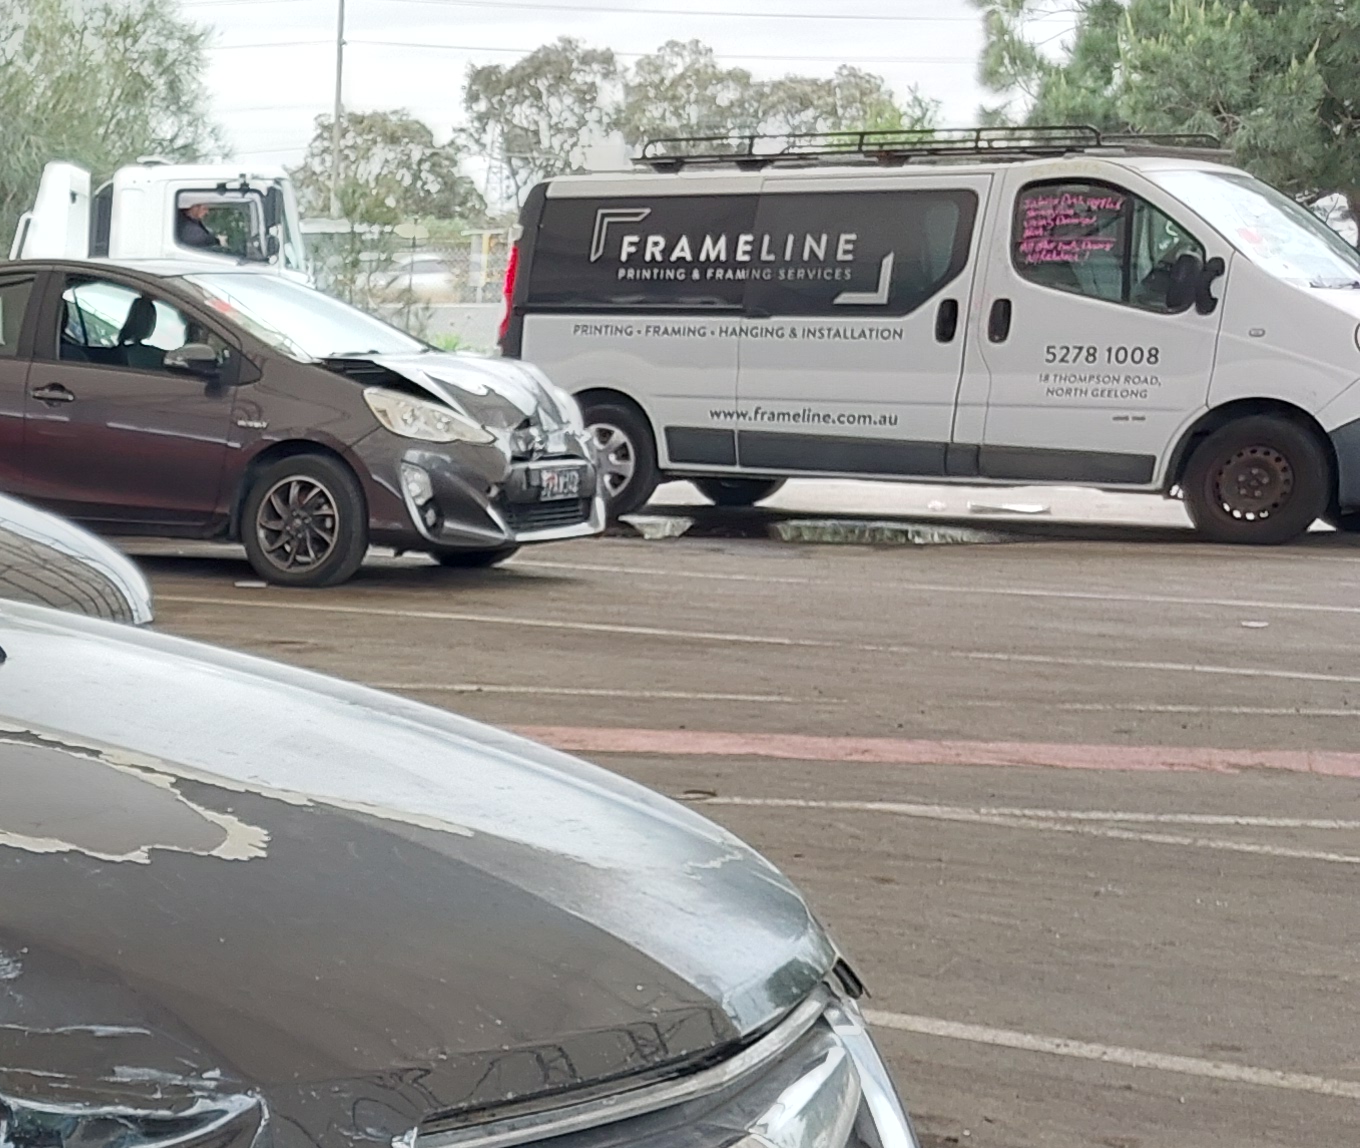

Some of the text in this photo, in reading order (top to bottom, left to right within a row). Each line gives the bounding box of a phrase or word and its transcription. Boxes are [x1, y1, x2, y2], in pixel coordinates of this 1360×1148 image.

[620, 233, 857, 262] FRAMELINE
[617, 267, 852, 281] PRINTING & FRAMING SERVICES
[573, 324, 904, 340] PRINTING FRAMING HANGING & INSTALLATION
[1045, 345, 1160, 365] 5278 1008
[1053, 374, 1121, 386] THOMPSON
[1046, 387, 1148, 399] NORTH GEELONG
[709, 406, 899, 426] www.frameline.com.au
